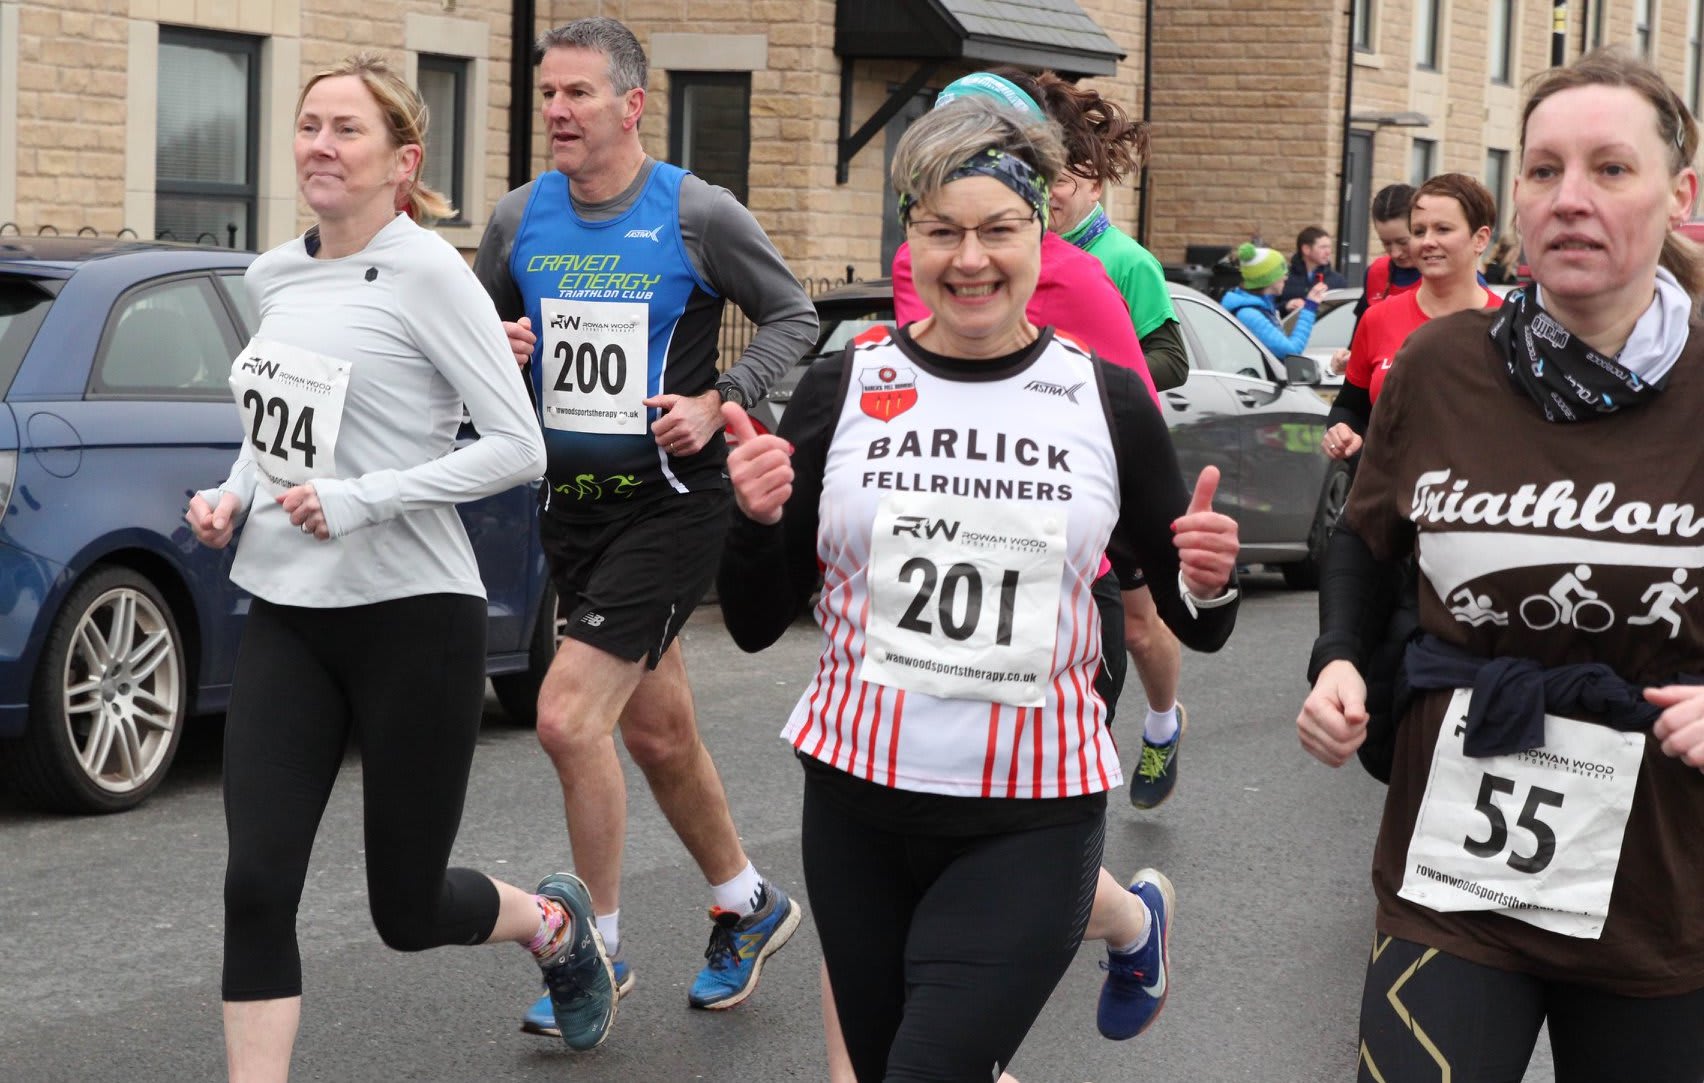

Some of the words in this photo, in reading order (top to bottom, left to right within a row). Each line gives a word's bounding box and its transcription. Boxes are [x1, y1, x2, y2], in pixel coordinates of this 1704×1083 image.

[527, 254, 620, 272] CRAVEN
[558, 272, 661, 290] ENERGY
[559, 290, 619, 299] TRIATHLON
[624, 290, 654, 300] CLUB
[553, 340, 627, 395] 200
[243, 389, 317, 469] 224
[867, 428, 1072, 473] BARLICK
[862, 471, 1073, 501] FELLRUNNERS
[1410, 468, 1704, 538] Triathlon
[962, 531, 1006, 543] ROWAN
[1010, 537, 1047, 548] WOOD
[896, 557, 1020, 646] 201
[885, 651, 1038, 683] wanwoodsportstherapy.co.uk
[1573, 760, 1614, 774] WOOD
[1463, 772, 1565, 874] 55
